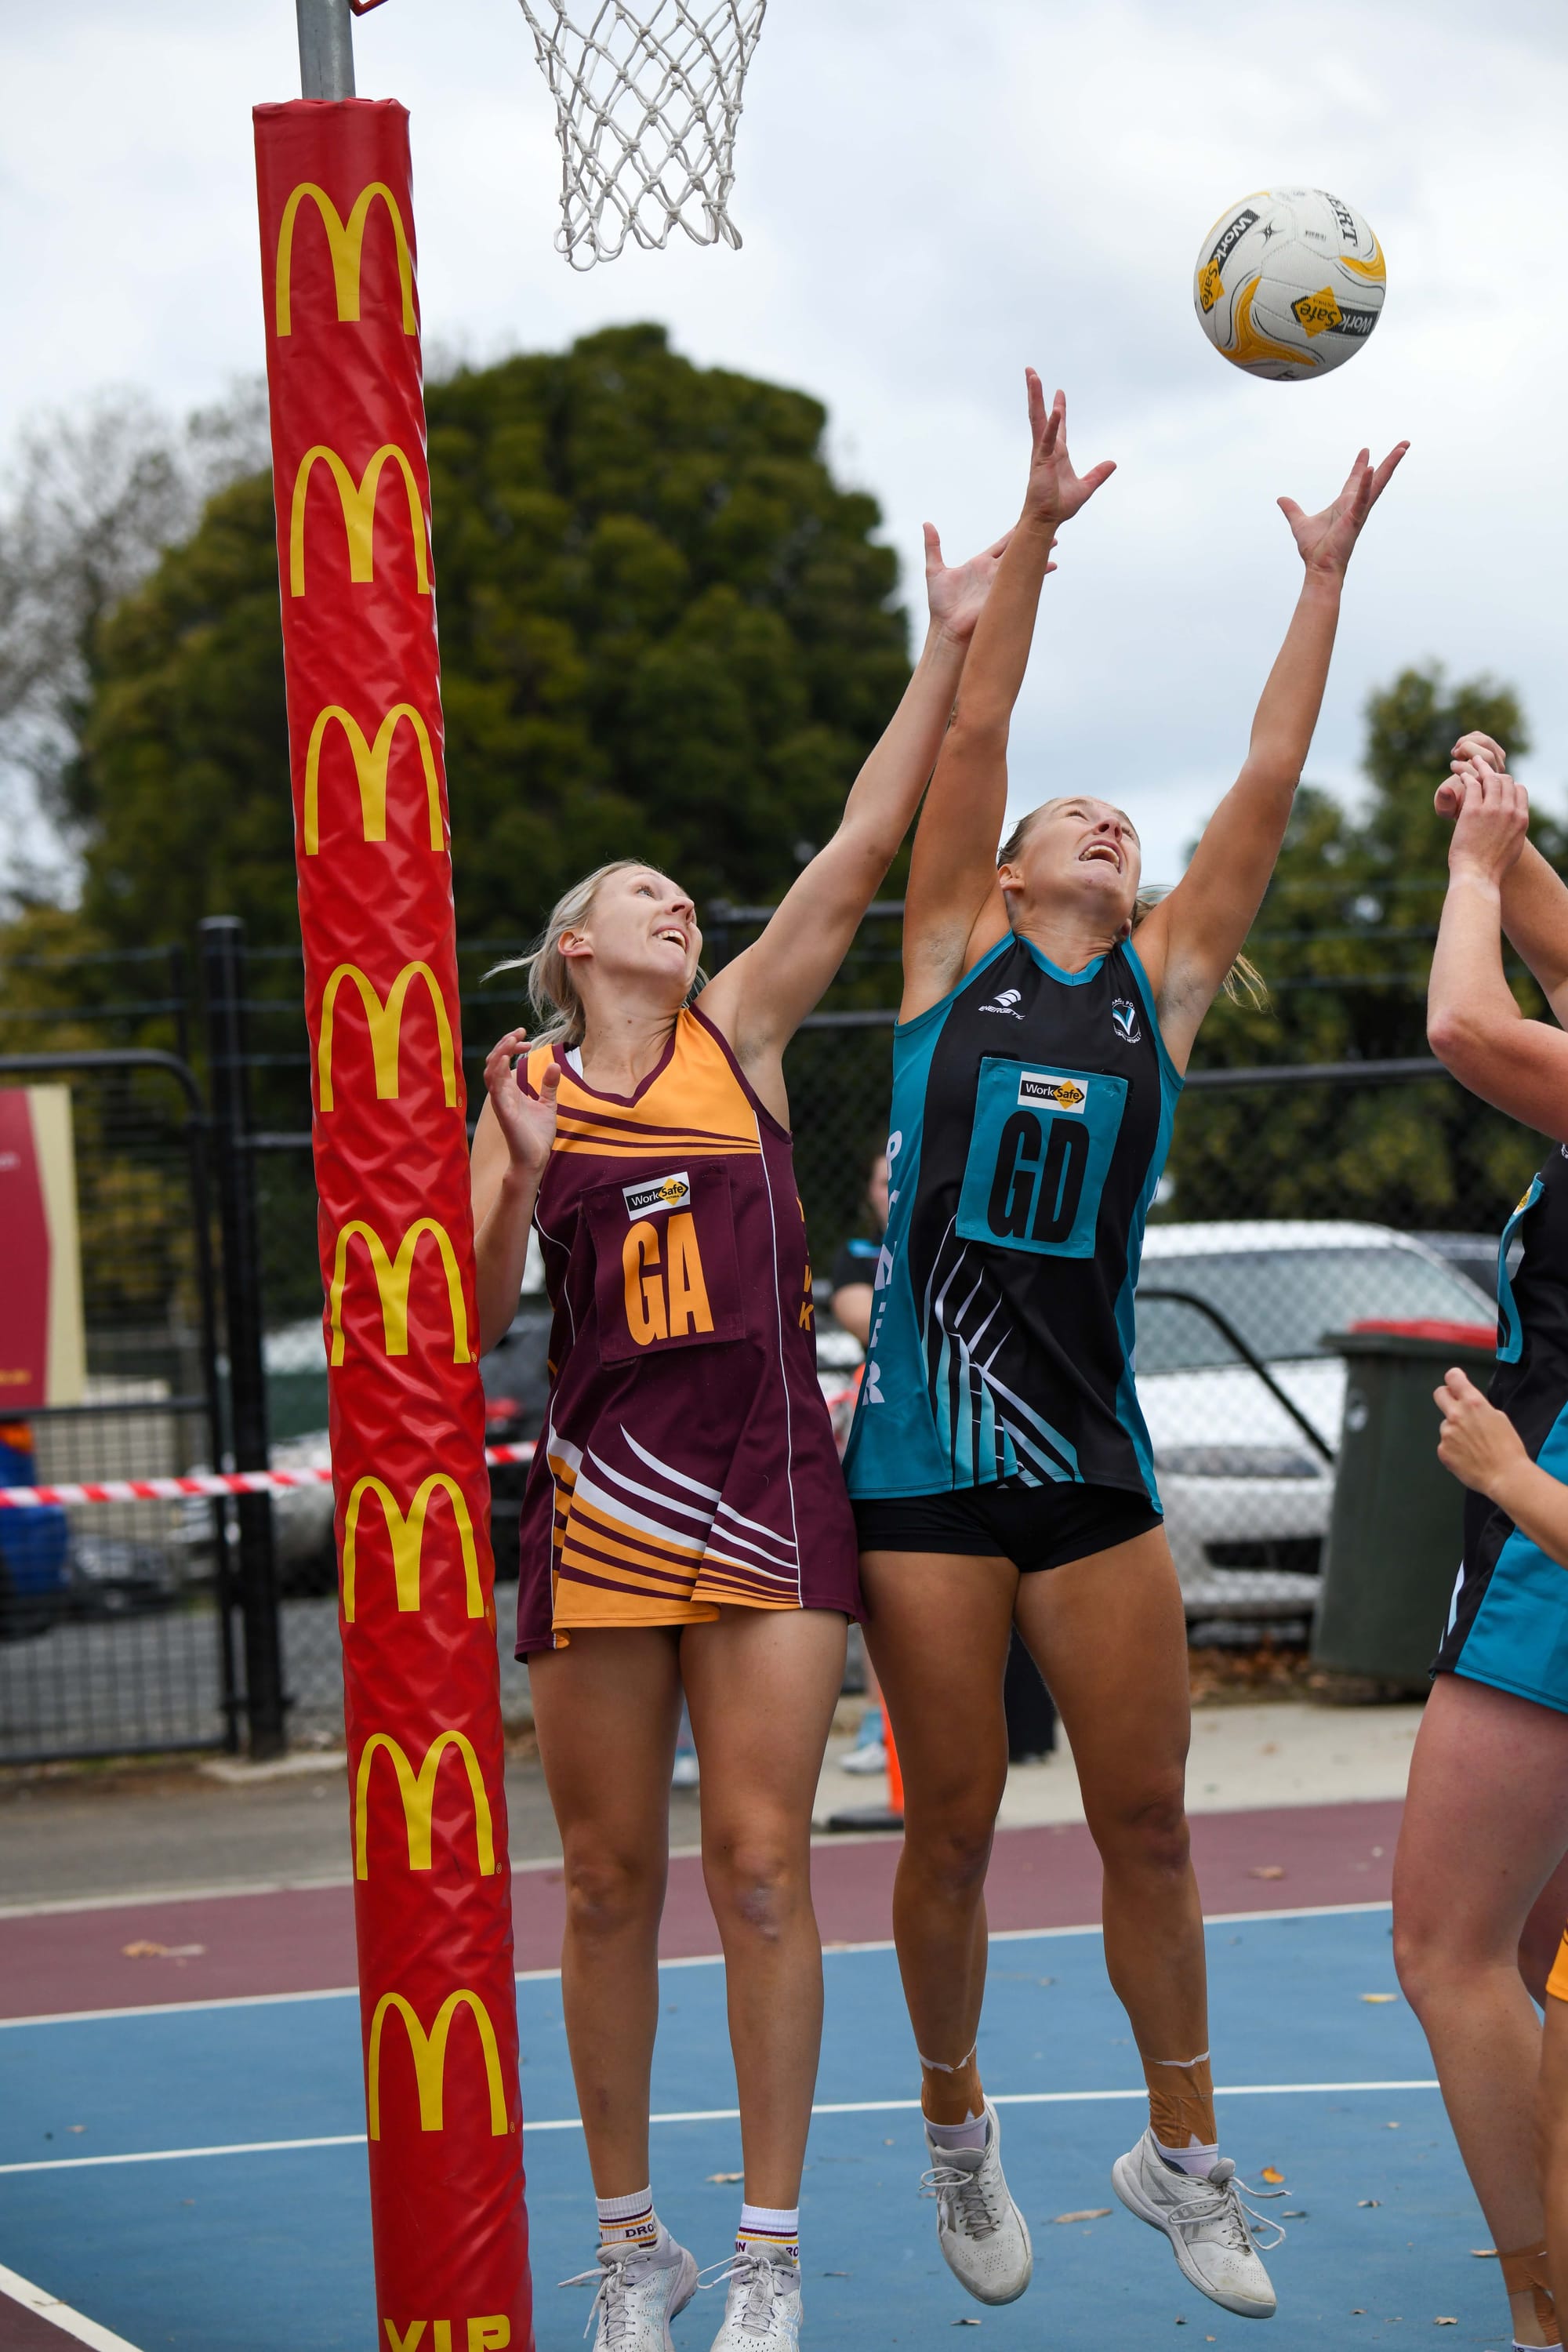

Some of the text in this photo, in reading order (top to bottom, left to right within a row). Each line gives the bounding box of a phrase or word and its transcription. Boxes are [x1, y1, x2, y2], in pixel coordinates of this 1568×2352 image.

[1025, 1083, 1080, 1100] WorkSafe
[631, 1185, 684, 1206] WorkSafe
[987, 1111, 1090, 1243] GD
[622, 1213, 713, 1345] GA
[383, 2314, 510, 2352] VIP
